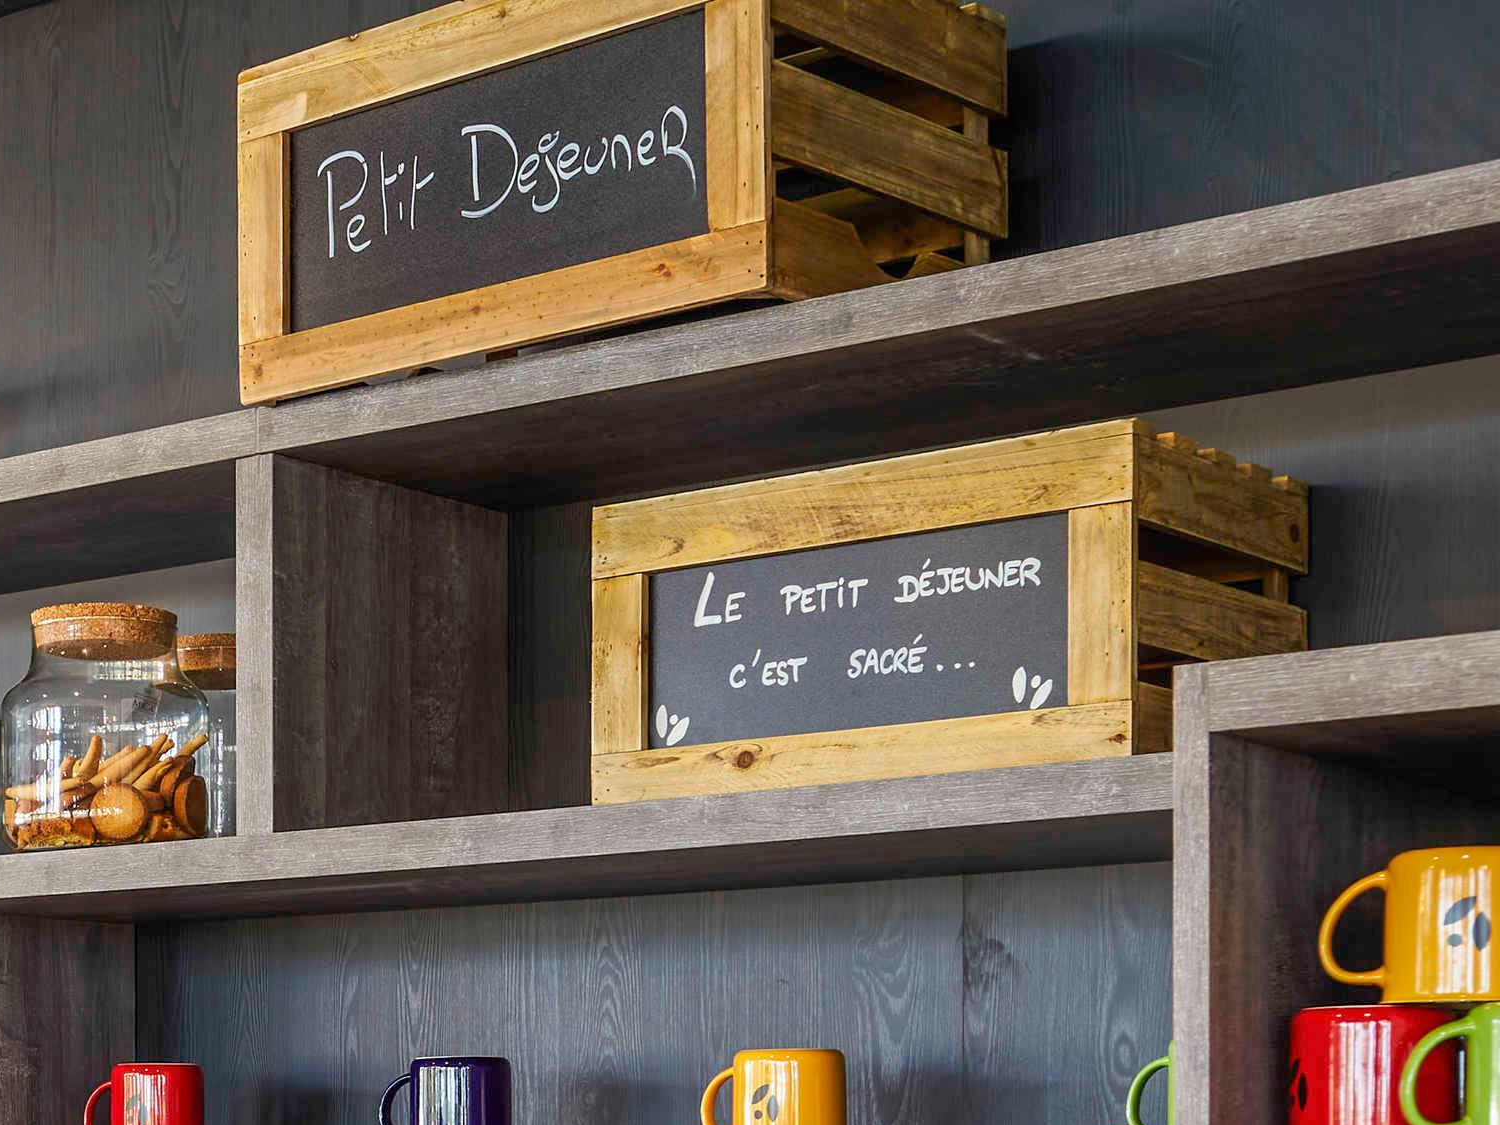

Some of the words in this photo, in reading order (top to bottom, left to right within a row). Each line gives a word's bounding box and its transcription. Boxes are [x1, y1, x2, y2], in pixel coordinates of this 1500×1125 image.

[317, 149, 435, 259] Petit
[780, 577, 868, 615] PETIT
[893, 558, 1041, 603] DÉJEUNER
[728, 649, 808, 689] C'EST
